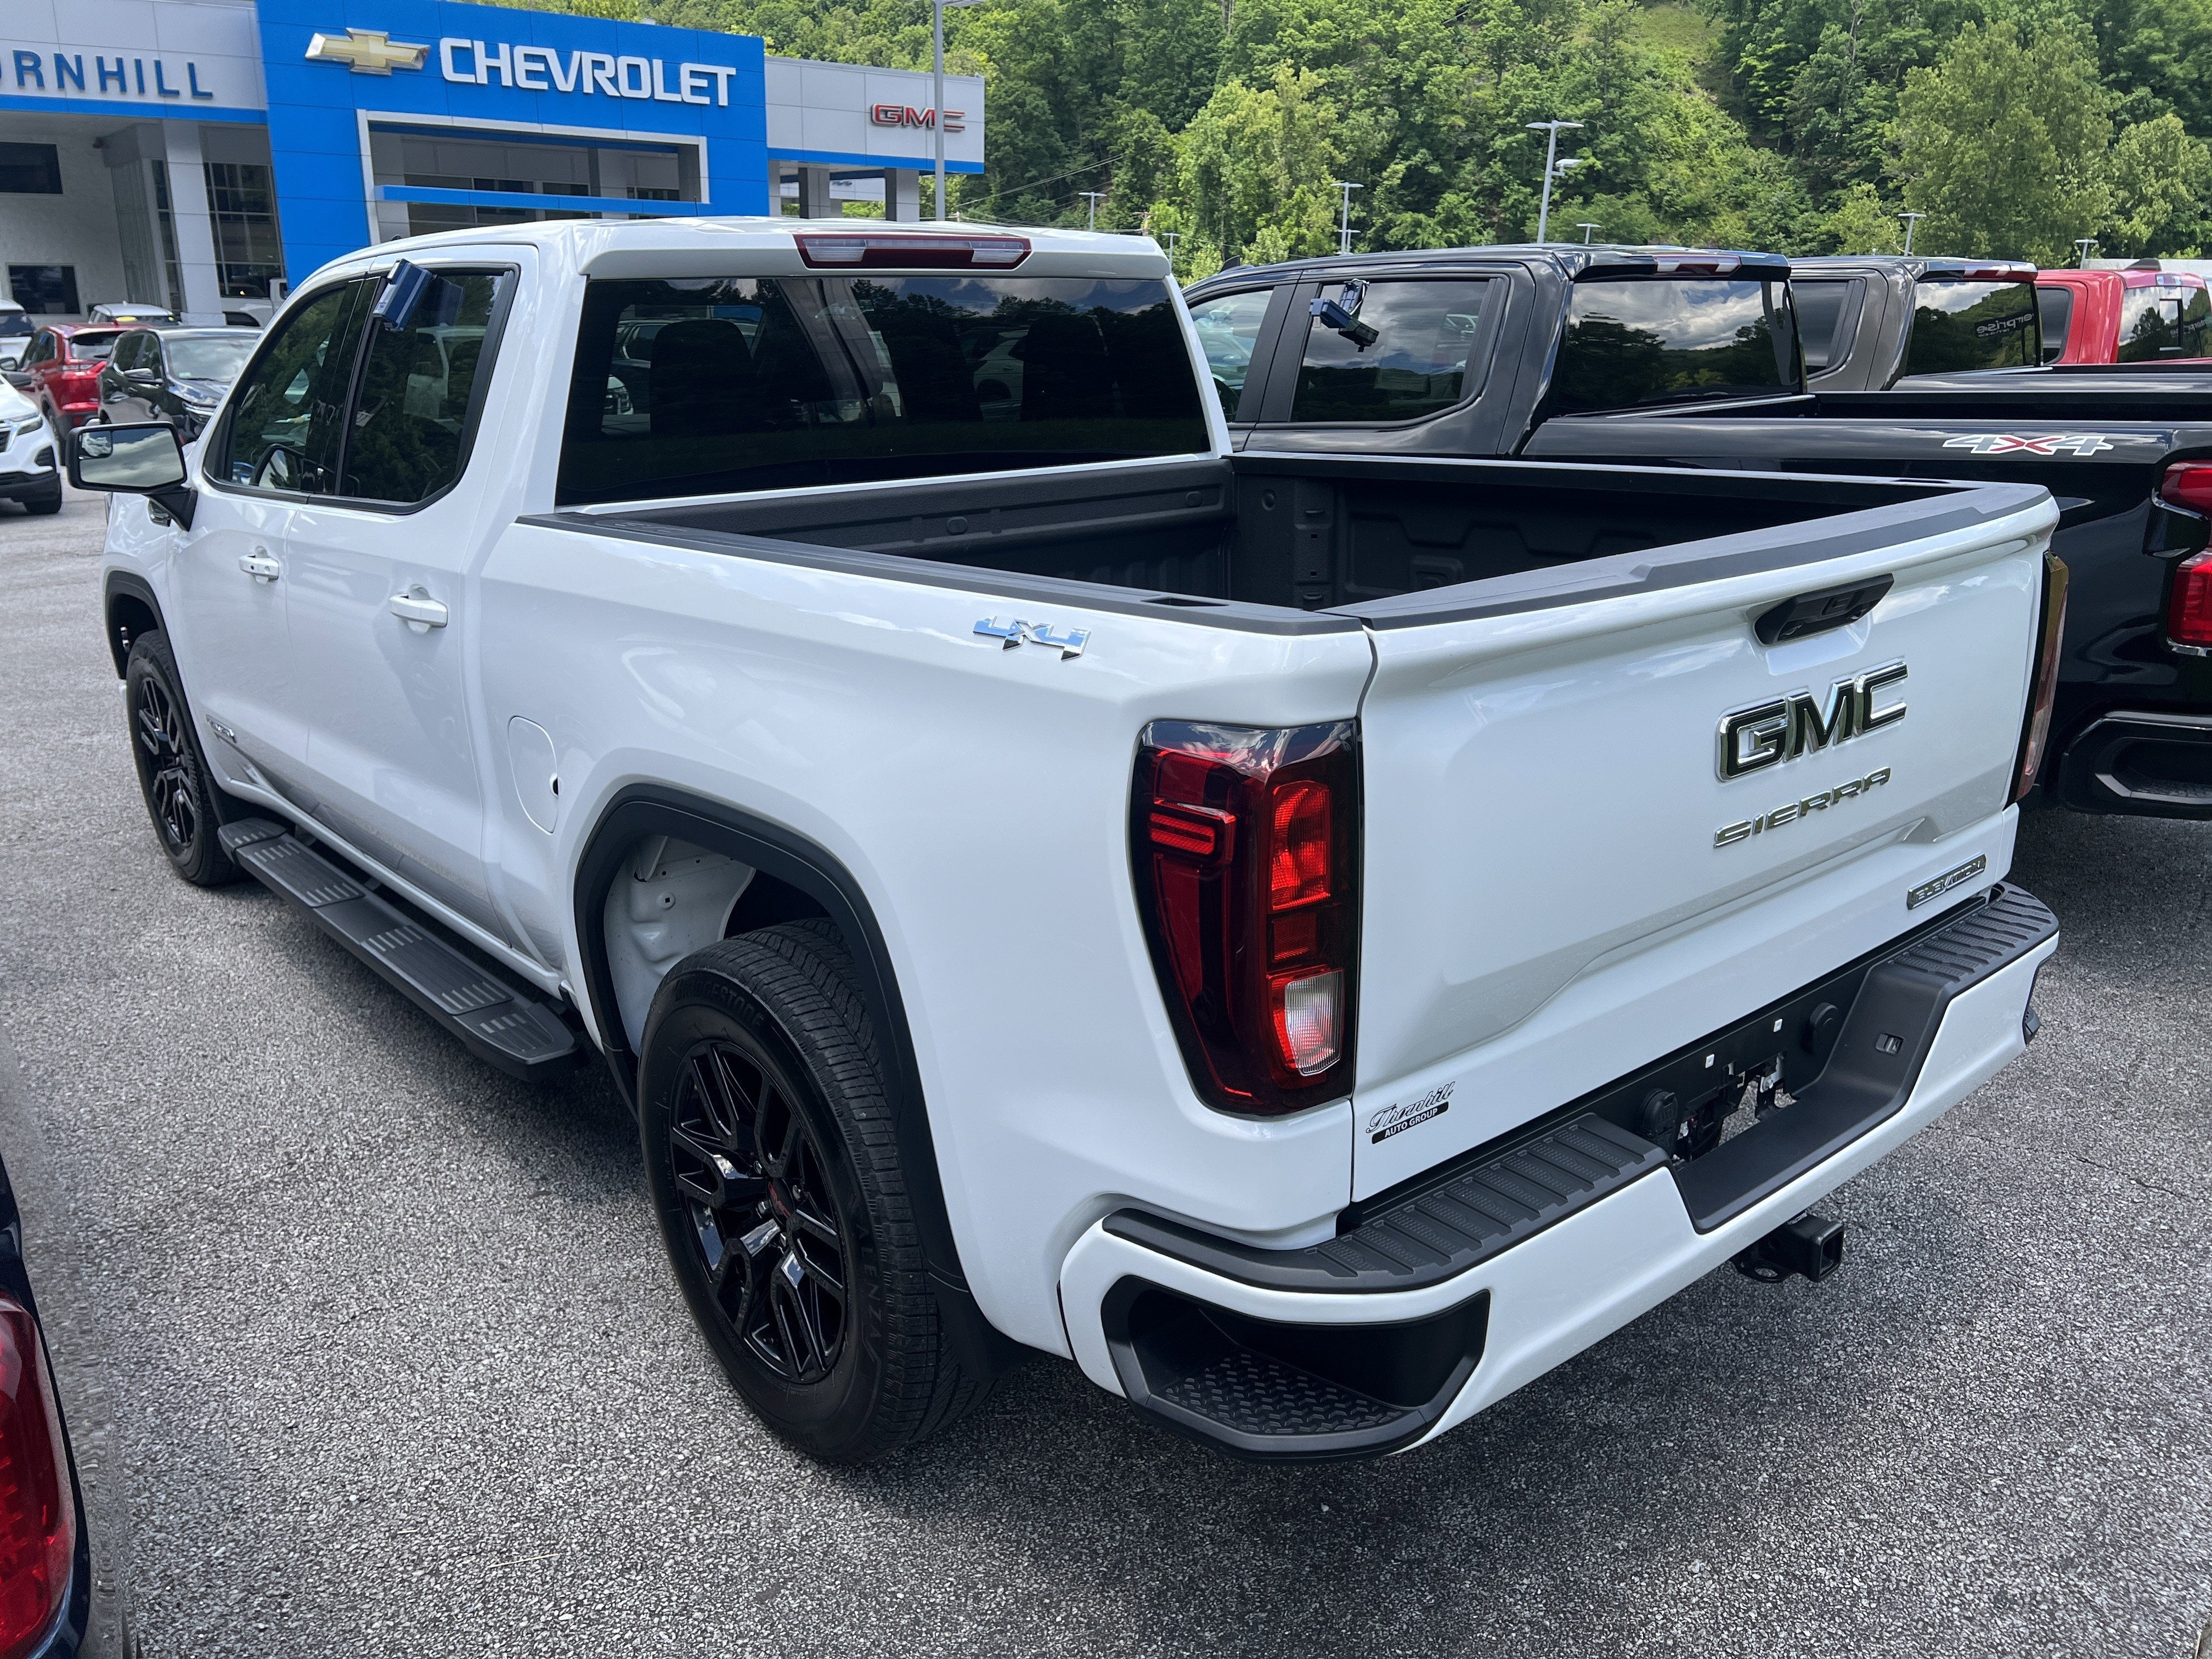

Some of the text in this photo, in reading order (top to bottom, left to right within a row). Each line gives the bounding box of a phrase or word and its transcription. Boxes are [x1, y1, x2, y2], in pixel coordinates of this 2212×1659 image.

[0, 50, 213, 99] RNHILL
[439, 37, 736, 106] CHEVROLET
[871, 103, 966, 131] GMC
[1718, 659, 1908, 781] GMC
[1713, 766, 1891, 848] SIERRA
[1365, 1081, 1455, 1133] Thornhill
[1384, 1108, 1438, 1138] AUTO GROUP
